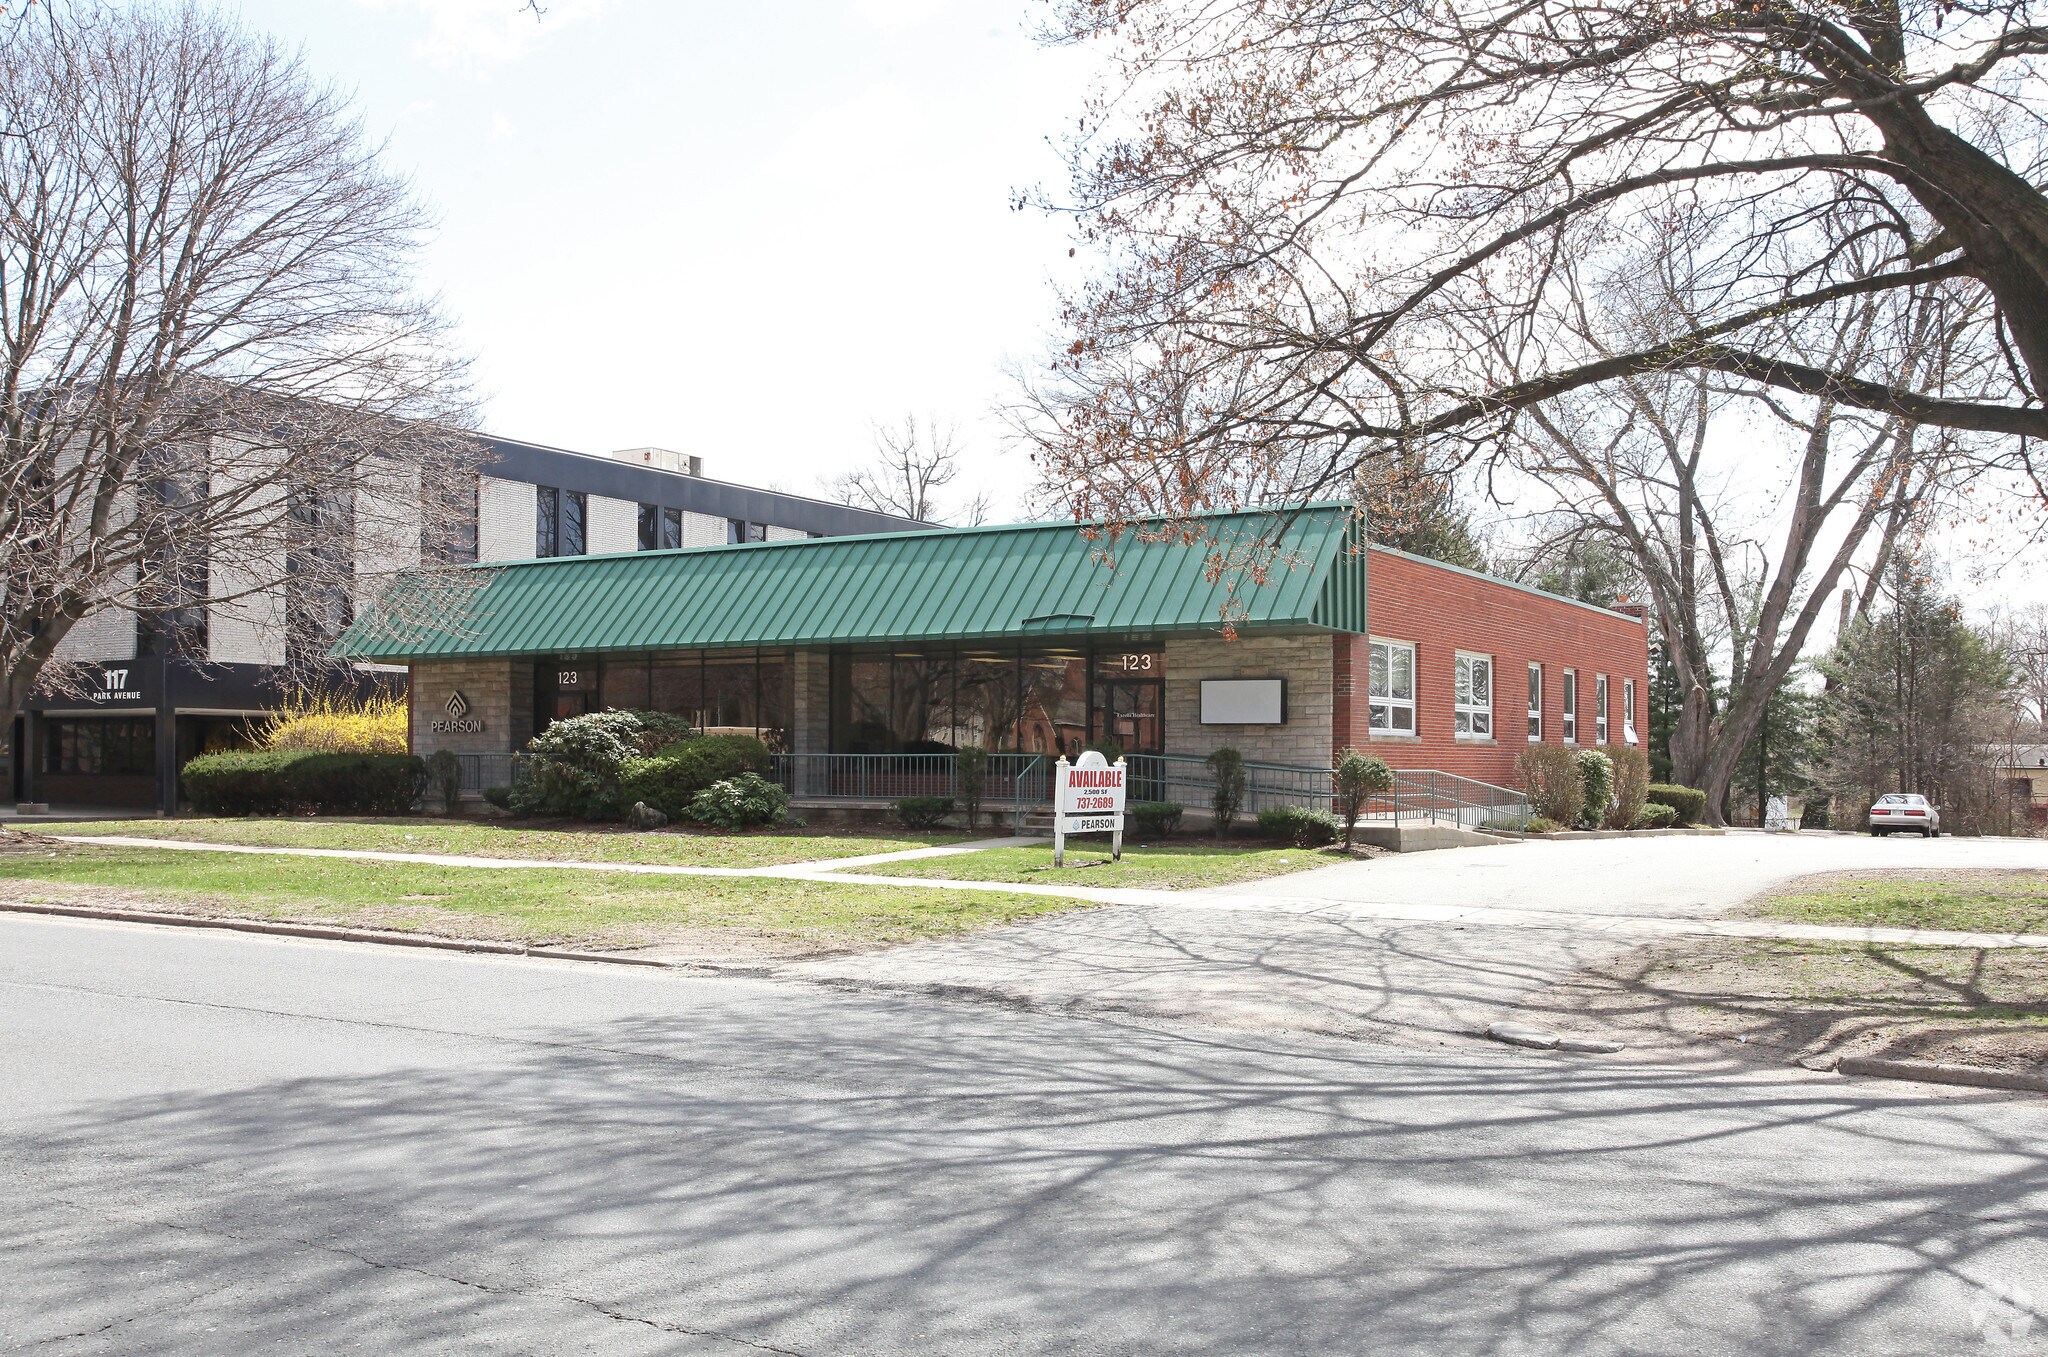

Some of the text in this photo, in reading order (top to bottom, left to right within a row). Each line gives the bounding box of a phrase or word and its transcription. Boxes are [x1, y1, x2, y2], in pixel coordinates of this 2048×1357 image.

[1122, 654, 1151, 671] 123
[105, 670, 129, 689] 117
[558, 671, 577, 684] 123
[114, 691, 141, 699] AVENUE
[431, 720, 481, 732] PEARSON
[1069, 771, 1122, 788] AVAILABLE
[1077, 797, 1114, 809] 737-2689
[1081, 819, 1115, 829] PEARSON
